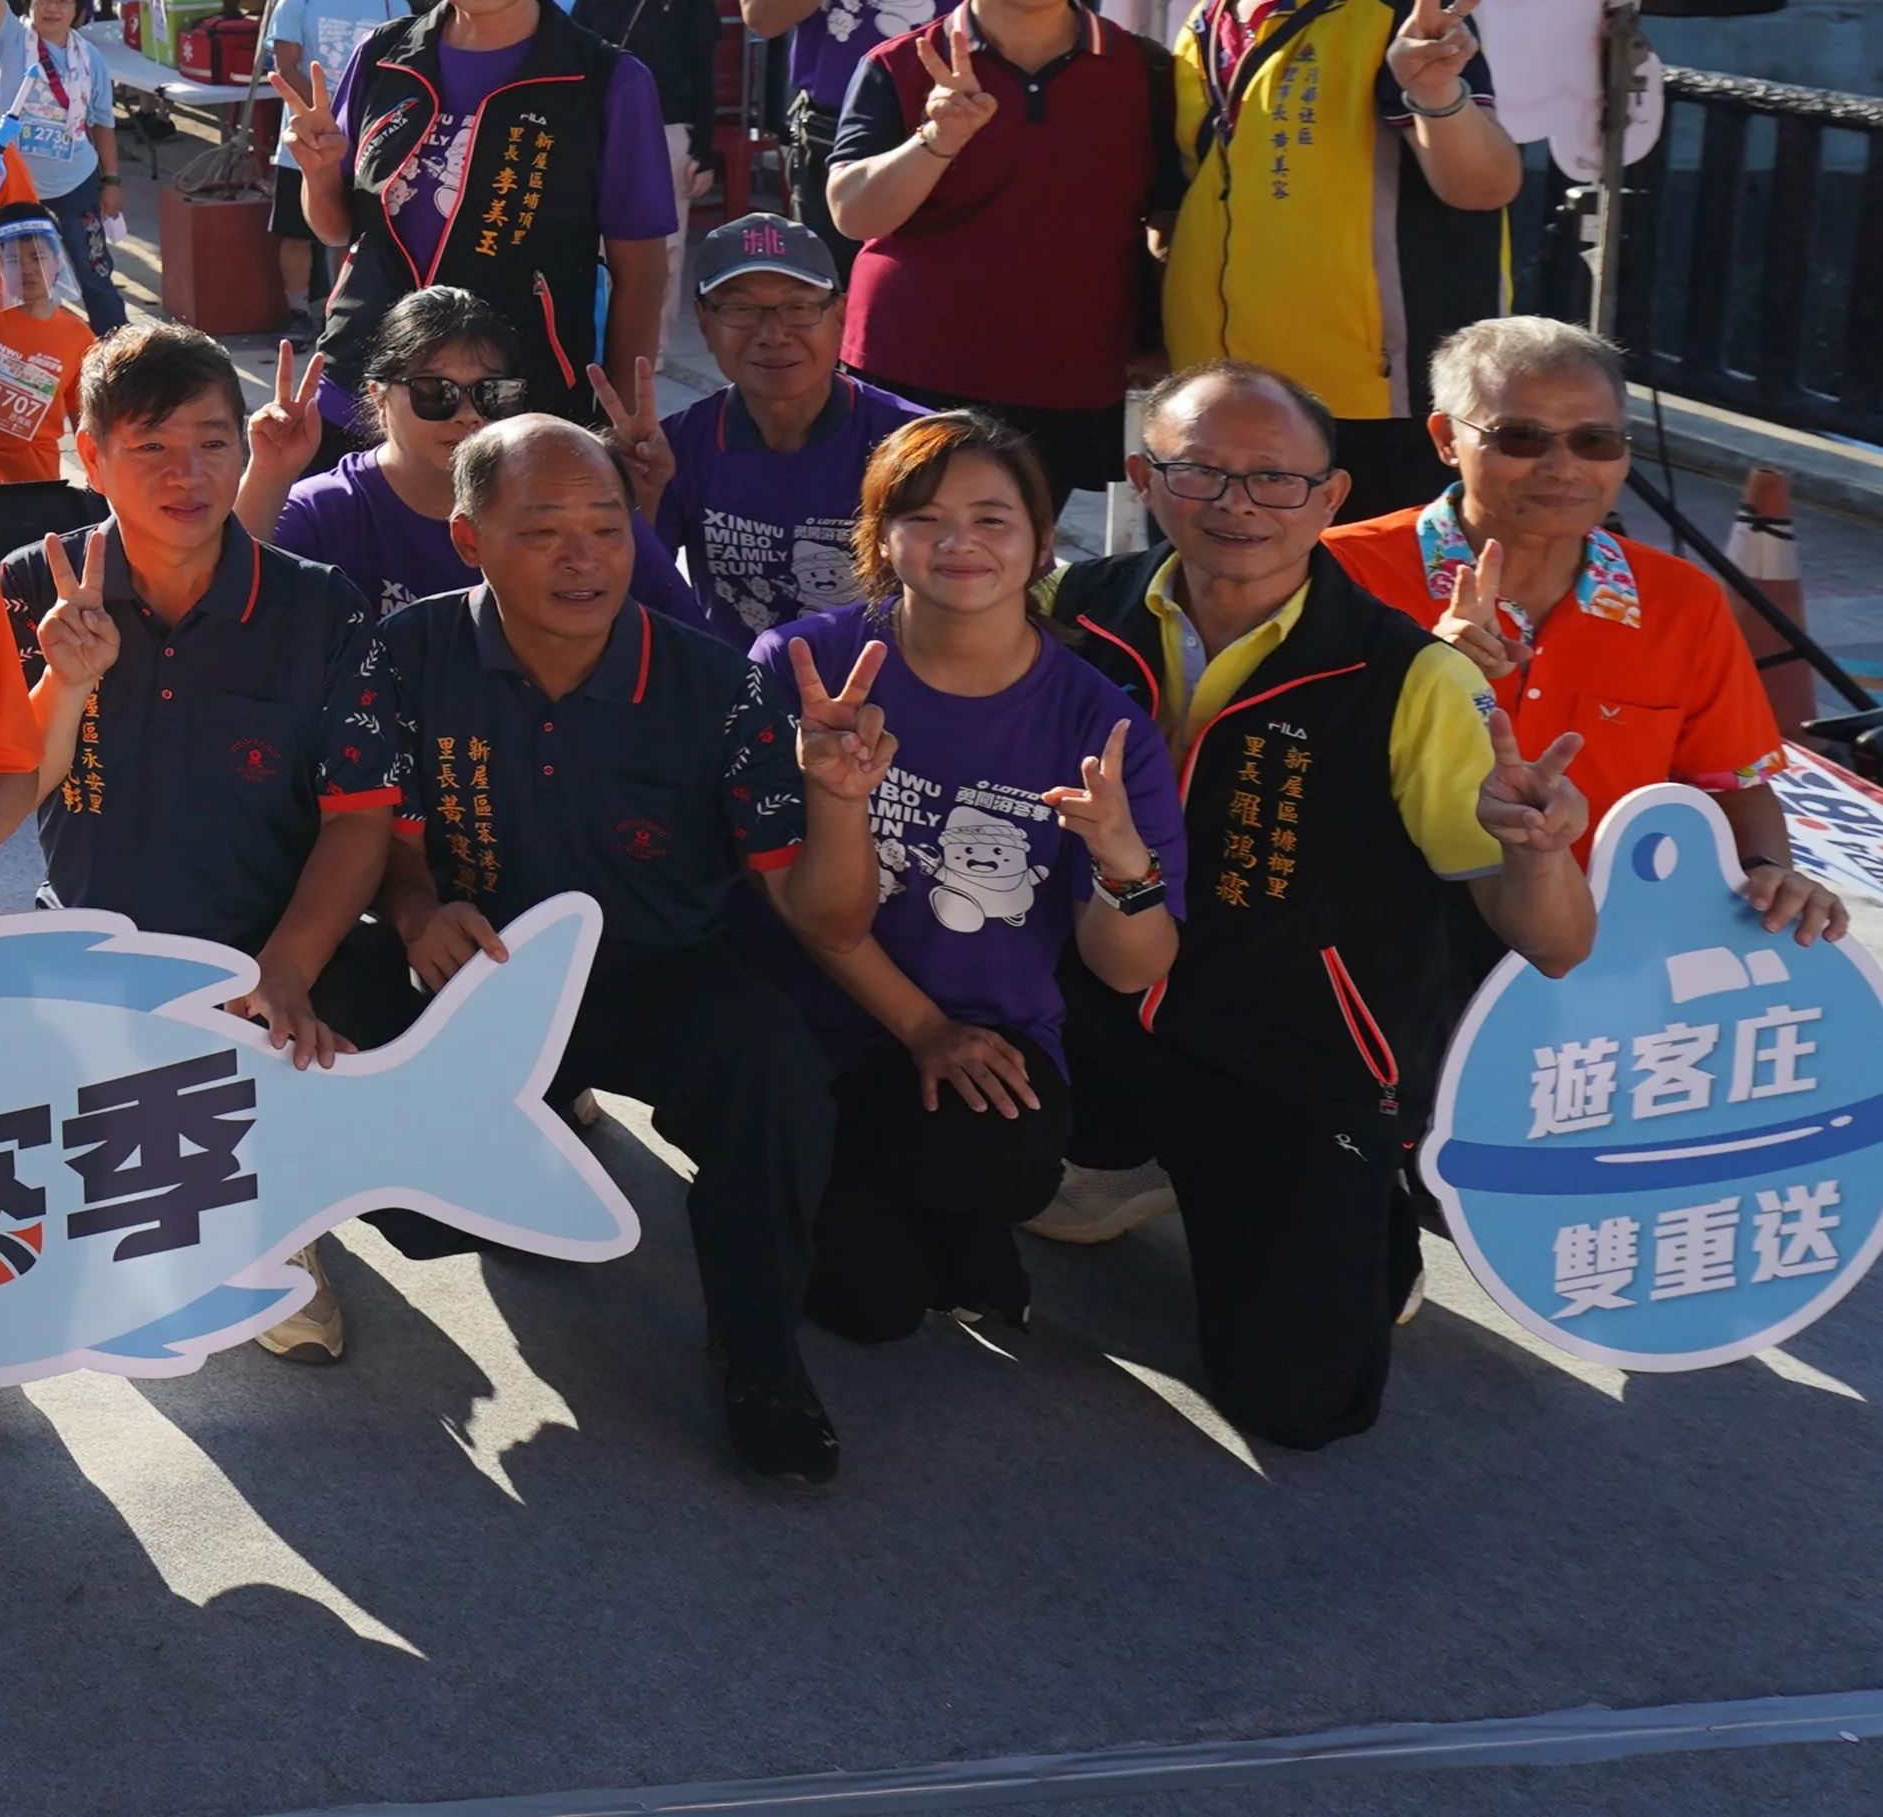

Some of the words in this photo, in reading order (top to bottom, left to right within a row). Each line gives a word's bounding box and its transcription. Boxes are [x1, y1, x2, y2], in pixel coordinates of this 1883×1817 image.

[21, 125, 31, 139] B
[702, 507, 784, 539] XINWU
[705, 526, 772, 549] MIBO
[707, 544, 788, 563] FAMILY
[708, 561, 764, 576] RUN
[1268, 721, 1308, 740] FILA
[873, 782, 922, 807] BO
[884, 767, 942, 798] NWU
[1526, 1003, 1824, 1141] 遊客庄
[1548, 1179, 1842, 1321] 雙重送
